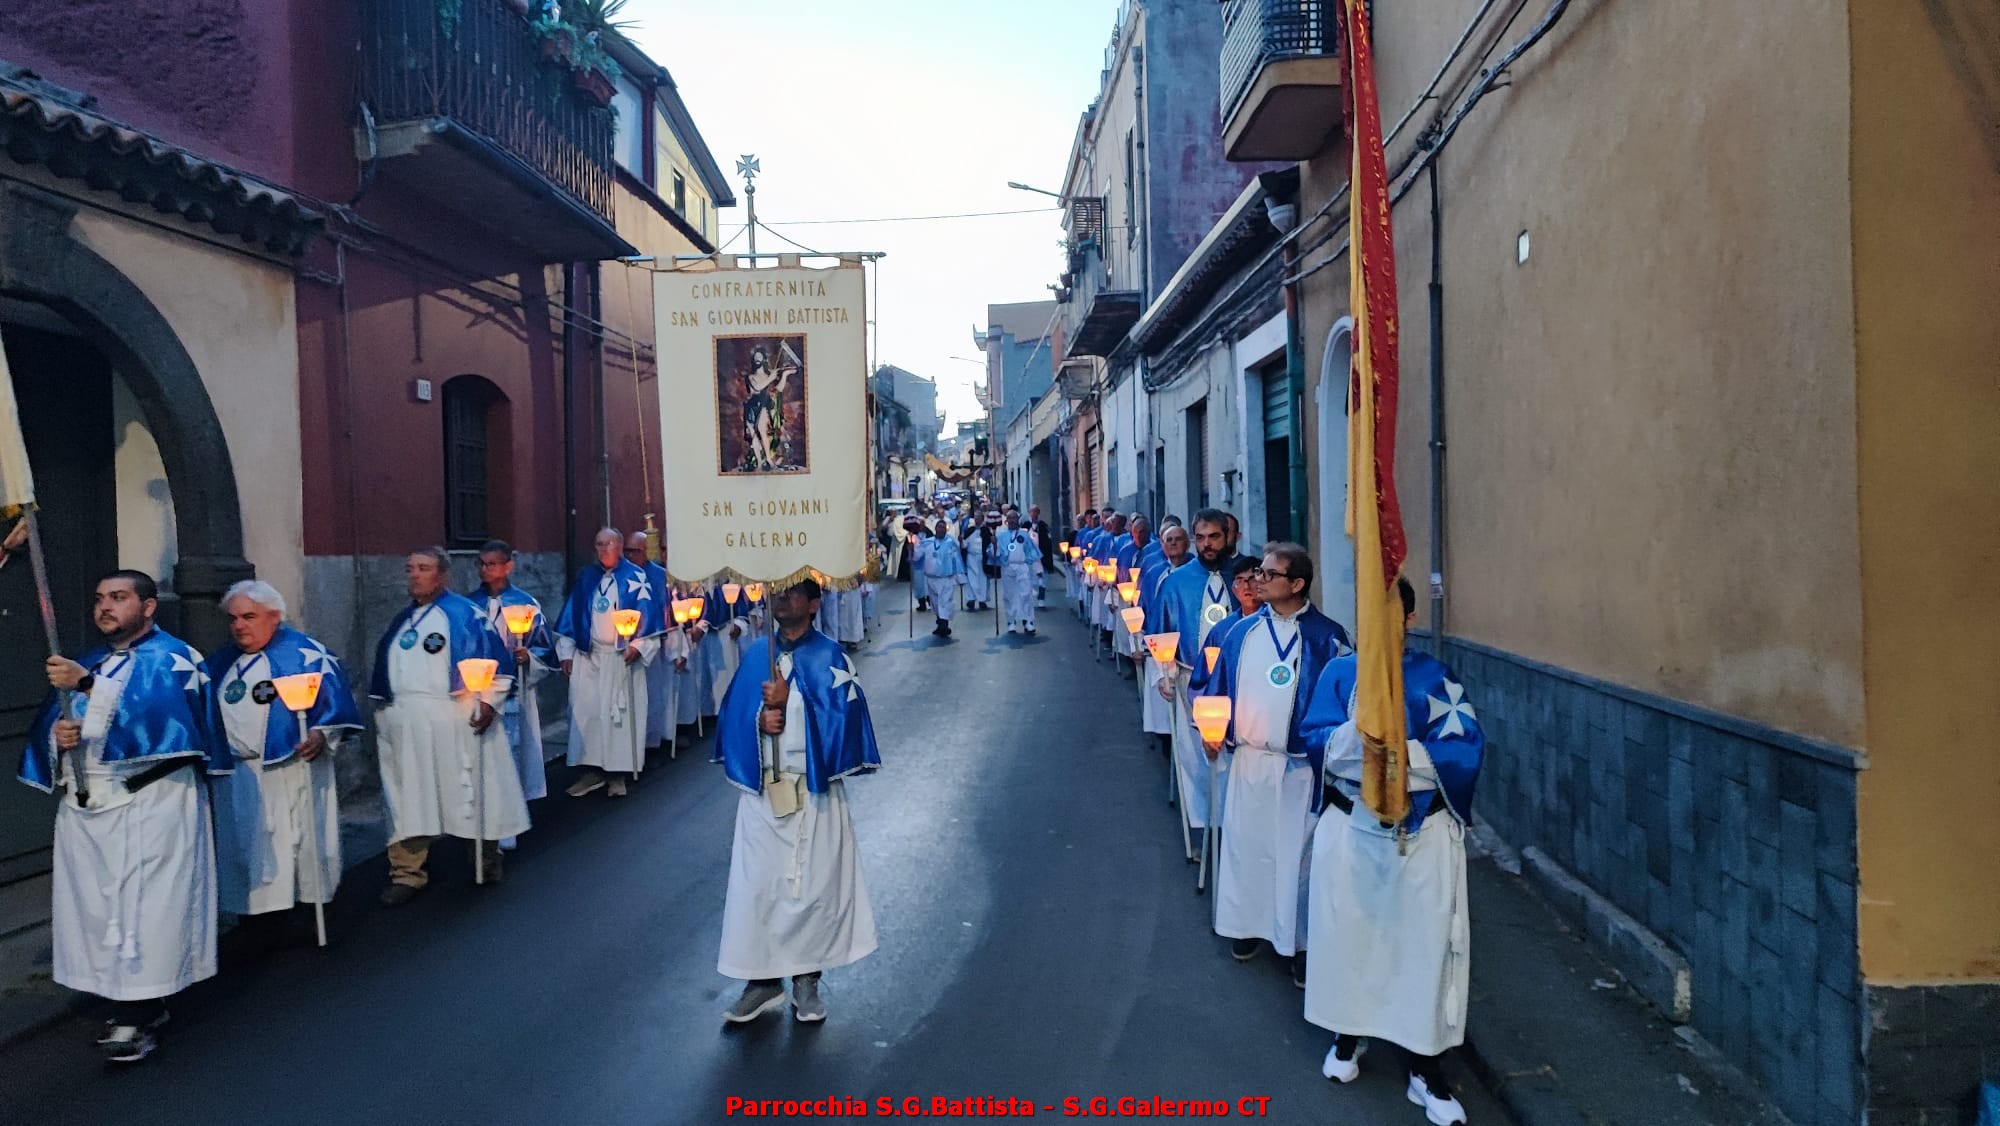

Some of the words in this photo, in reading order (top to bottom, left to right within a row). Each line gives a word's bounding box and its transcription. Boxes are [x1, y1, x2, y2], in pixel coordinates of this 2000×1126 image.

[691, 280, 827, 300] CONFRATERNITA
[671, 311, 699, 328] SAN
[707, 309, 778, 326] GIOVANNI
[787, 306, 849, 325] BATTISTA
[702, 501, 733, 517] SAN
[748, 498, 829, 516] GIOVANNI
[725, 531, 807, 548] GALERMO
